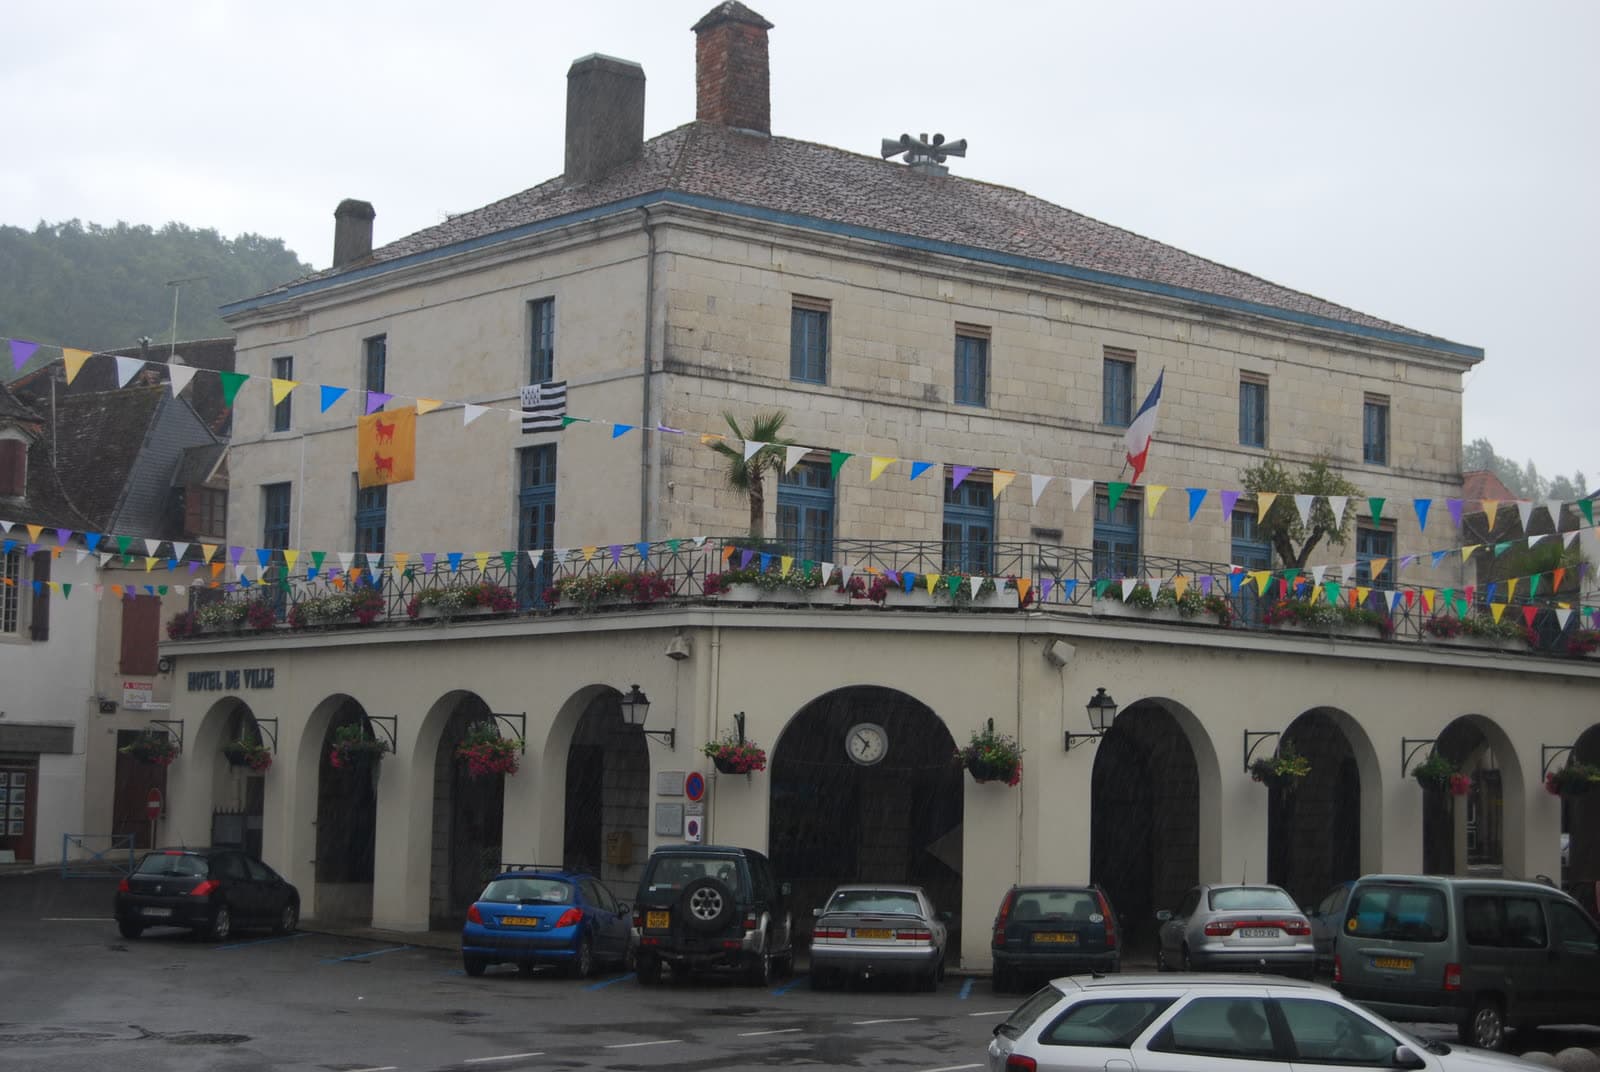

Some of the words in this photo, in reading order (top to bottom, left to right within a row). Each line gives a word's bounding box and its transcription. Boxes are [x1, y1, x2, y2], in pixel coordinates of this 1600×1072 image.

[188, 671, 223, 691] HOTEL
[225, 670, 240, 690] DE
[243, 668, 275, 689] VILLE
